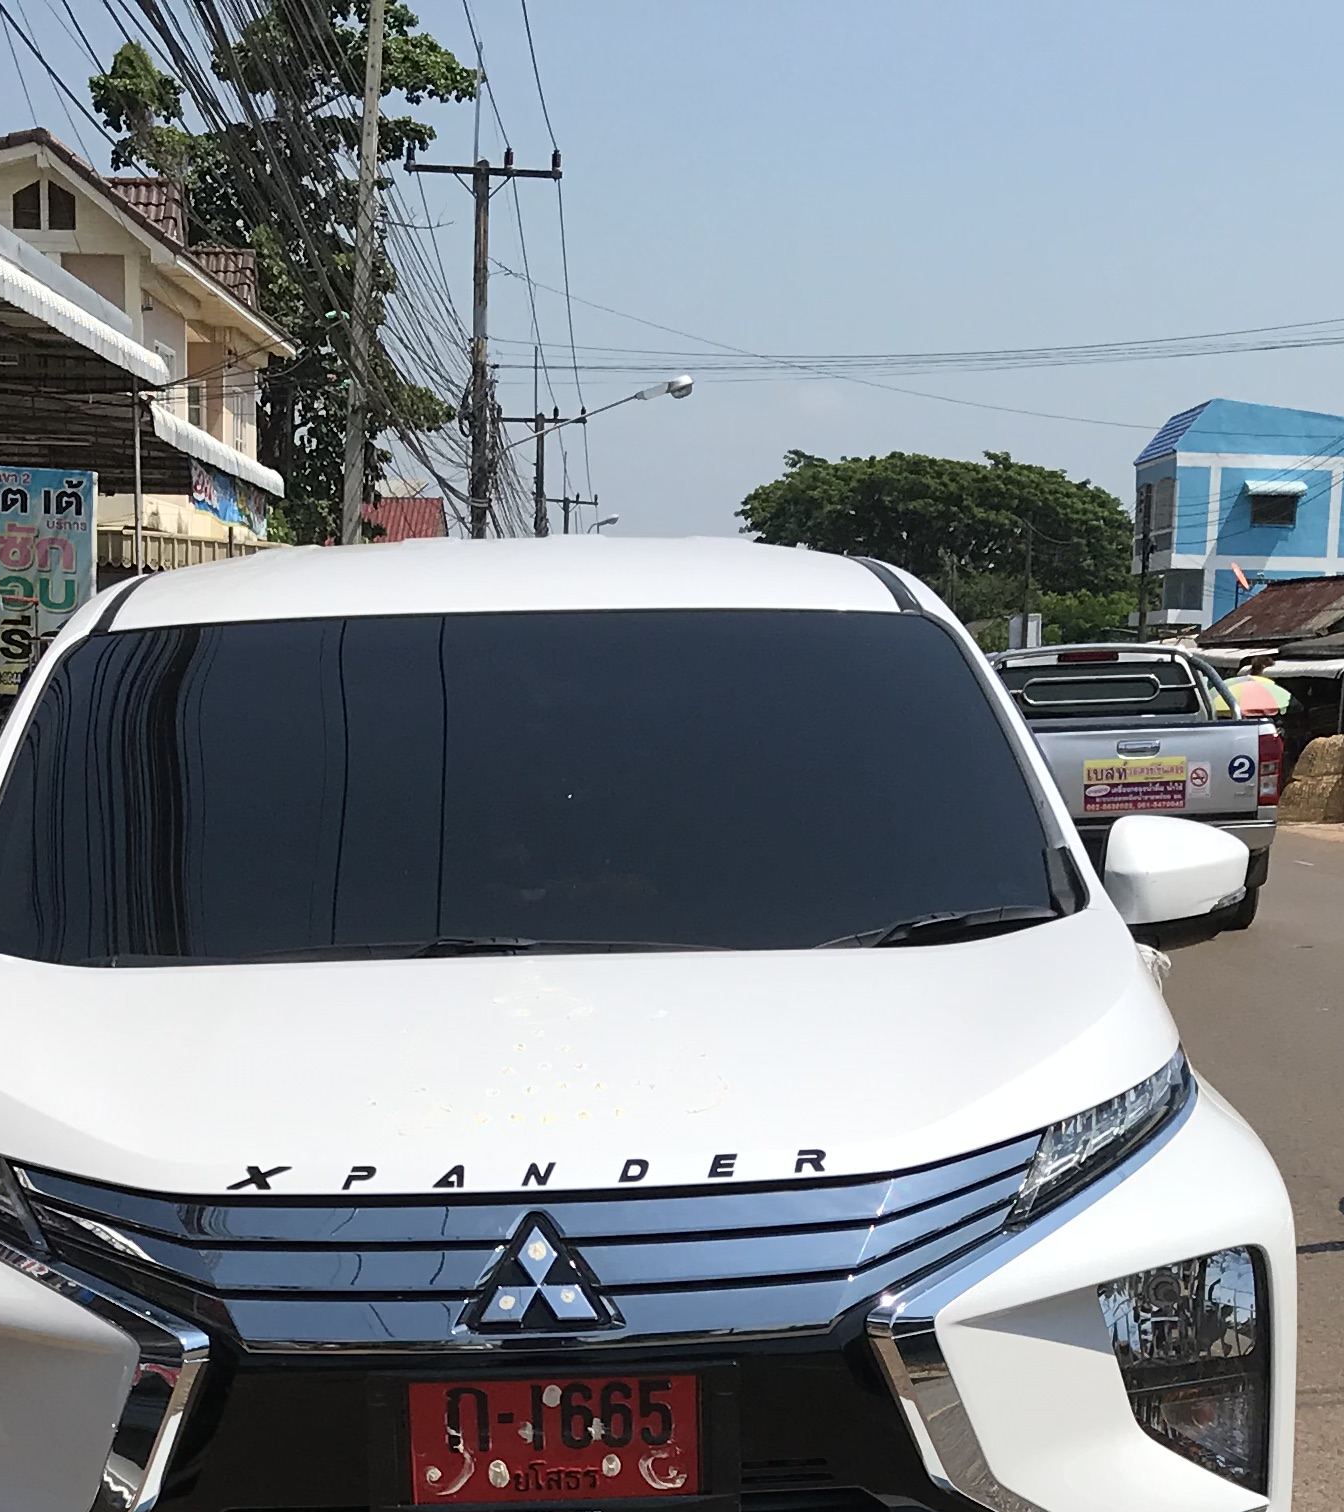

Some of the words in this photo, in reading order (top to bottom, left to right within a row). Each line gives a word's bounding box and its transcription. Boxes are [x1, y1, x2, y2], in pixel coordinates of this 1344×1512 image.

[22, 473, 31, 484] 2
[43, 480, 84, 516] เต้
[46, 519, 87, 532] บริการ
[1232, 758, 1250, 779] 2
[227, 1149, 827, 1191] XPANDER
[513, 1459, 599, 1493] ยโสธร
